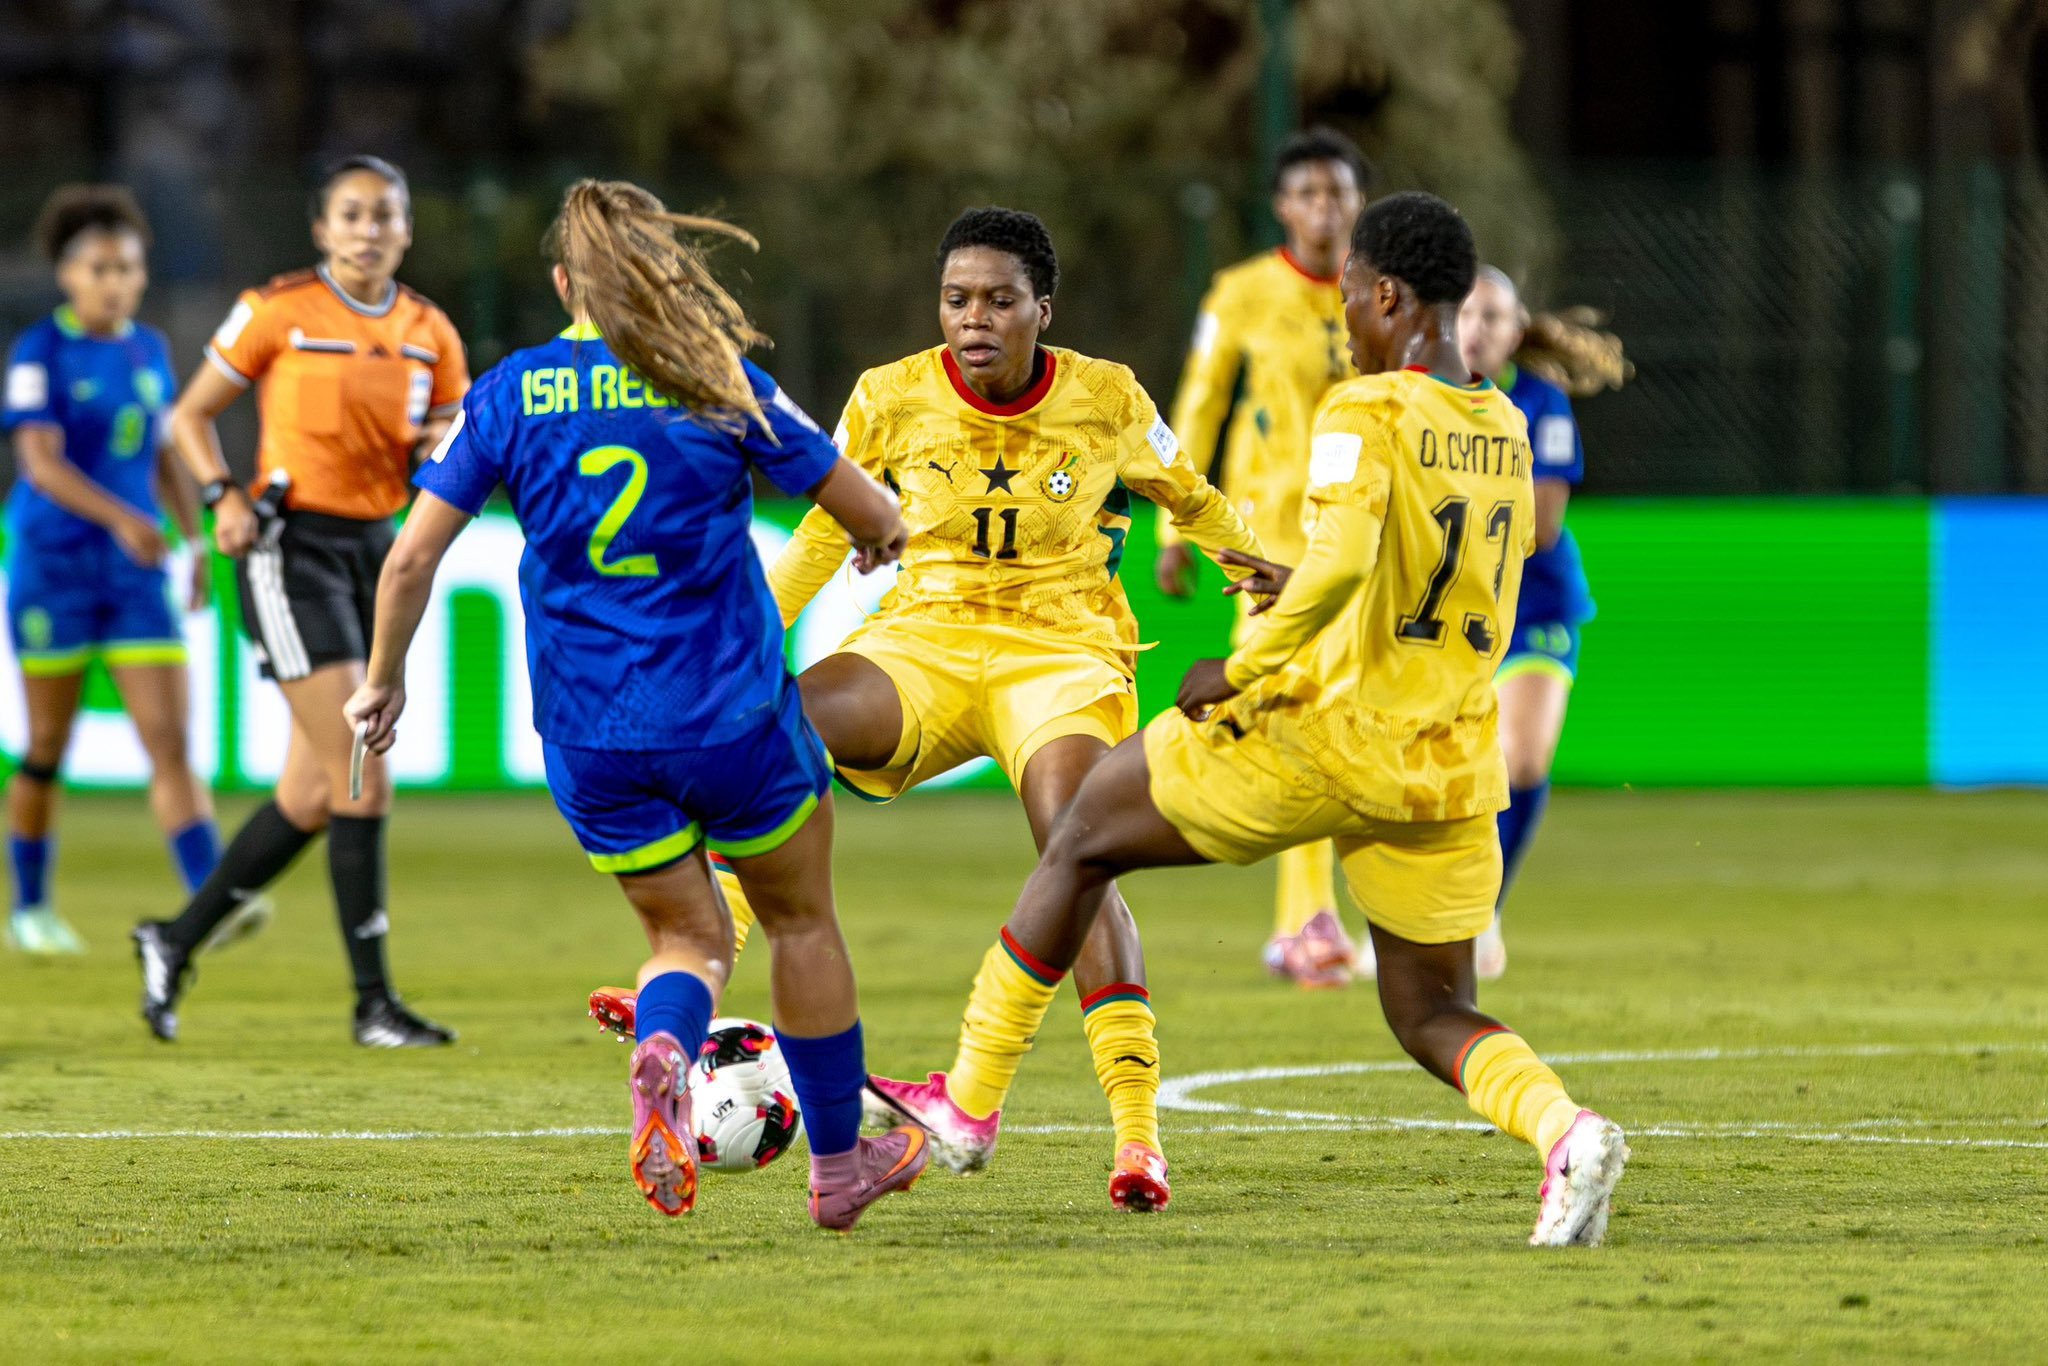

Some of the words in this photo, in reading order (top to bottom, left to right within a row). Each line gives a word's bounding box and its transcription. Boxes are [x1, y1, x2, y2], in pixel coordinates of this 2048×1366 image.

[521, 367, 578, 416] ISA
[578, 445, 660, 577] 2
[972, 507, 1020, 560] 11
[1396, 495, 1515, 660] 13
